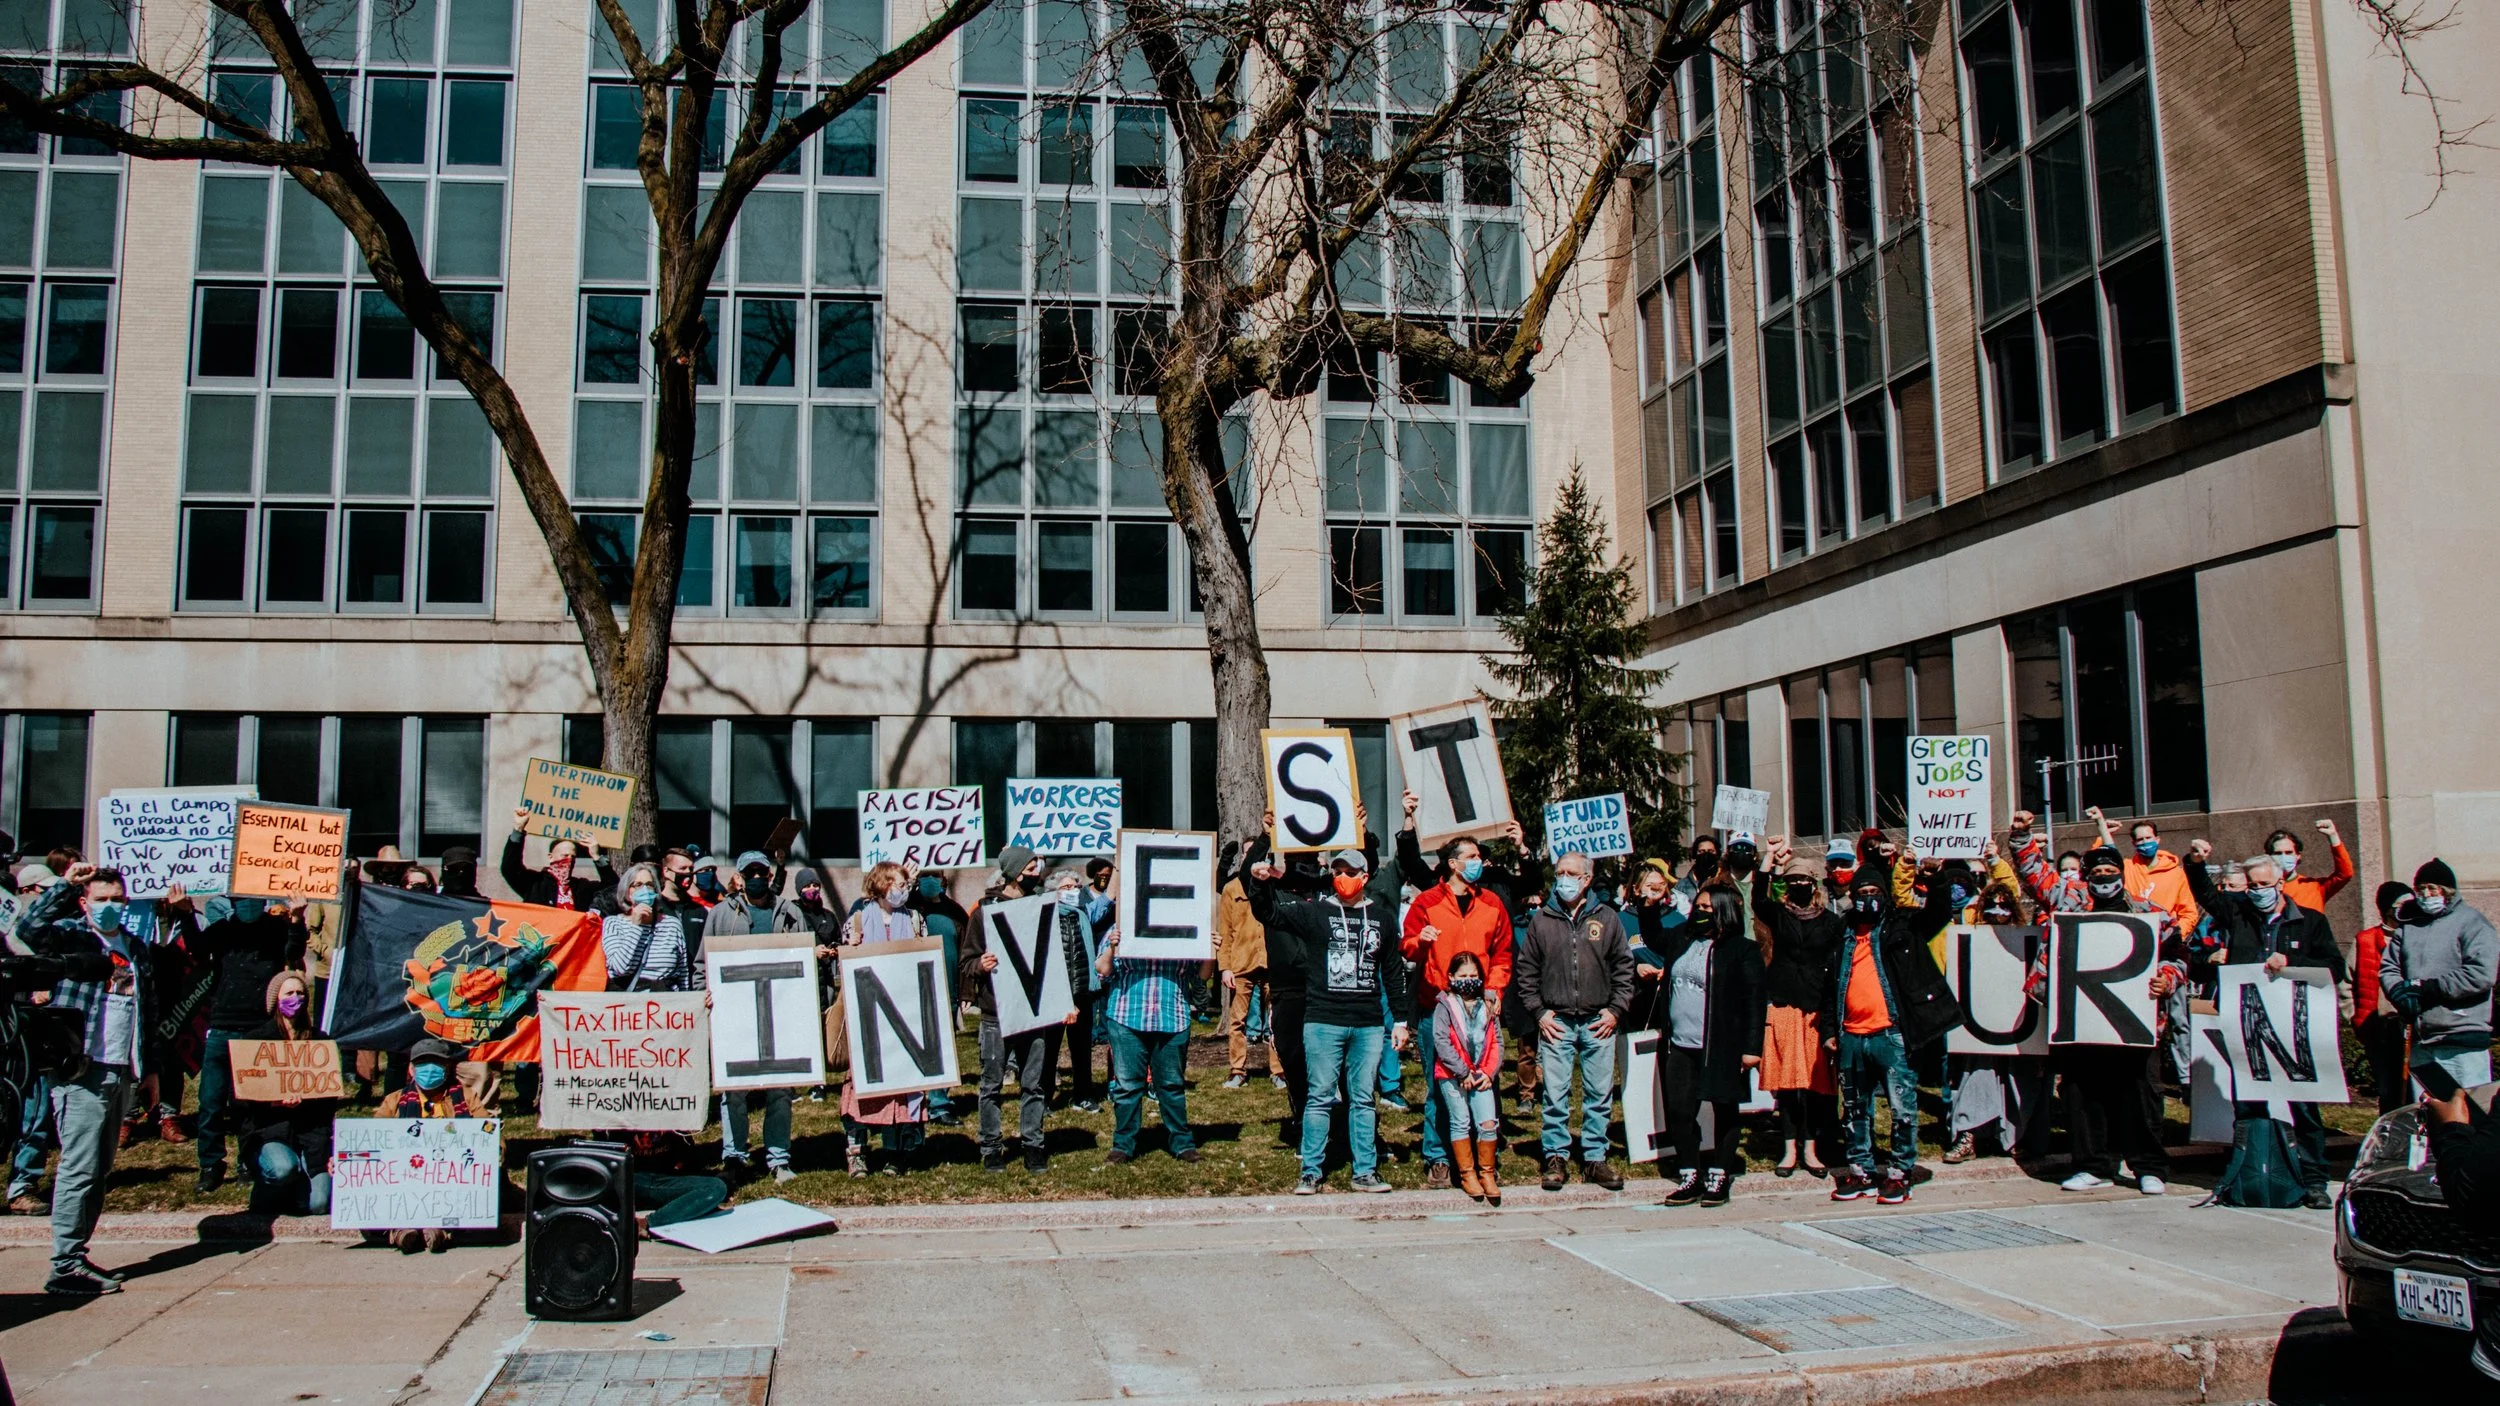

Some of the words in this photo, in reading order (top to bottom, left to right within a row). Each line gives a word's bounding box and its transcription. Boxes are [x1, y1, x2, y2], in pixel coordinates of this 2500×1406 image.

[1911, 738, 1988, 759] Green
[539, 761, 628, 792] OVERTHROW
[1408, 716, 1479, 823] T
[552, 785, 580, 800] THE
[863, 788, 981, 813] RACISM
[1278, 742, 1340, 846] S
[1928, 788, 1970, 798] NOT
[524, 799, 620, 830] BILLIONAIRE
[1547, 797, 1621, 823] #FUND
[1918, 812, 1977, 829] WHITE
[189, 826, 209, 836] no
[242, 810, 309, 832] ESSENTIAL
[319, 819, 341, 836] but
[885, 814, 966, 841] TOOL
[1553, 820, 1619, 841] EXCLUDED
[273, 835, 342, 858] EXCLUDED
[872, 833, 880, 843] A
[1552, 833, 1627, 857] WORKERS
[178, 843, 231, 860] don't
[239, 851, 300, 872] Esencial
[309, 865, 339, 877] pero
[902, 839, 983, 867] RICH
[167, 863, 199, 878] you
[132, 876, 172, 894] eat
[268, 873, 339, 896] Excluido
[1134, 844, 1200, 939] E
[991, 902, 1056, 1017] V
[1957, 933, 2040, 1046] U
[2050, 914, 2156, 1045] R
[444, 1018, 487, 1028] UPSTATE
[488, 1020, 503, 1028] NY
[720, 961, 813, 1077] I
[854, 960, 945, 1084] N
[2240, 980, 2319, 1082] N
[452, 1026, 491, 1041] SRA
[275, 1070, 341, 1094] TODOS
[338, 1128, 394, 1151] SHARE
[422, 1130, 490, 1150] WEALTH
[337, 1160, 400, 1188] SHARE
[402, 1167, 424, 1181] the
[423, 1160, 493, 1187] HEALTH
[339, 1194, 377, 1222] FAIR
[385, 1190, 455, 1221] TAXES
[460, 1190, 495, 1220] ALL
[2413, 1275, 2428, 1285] NEW
[2430, 1278, 2449, 1288] YORK
[2400, 1283, 2425, 1311] KHL
[2433, 1287, 2464, 1317] 4375
